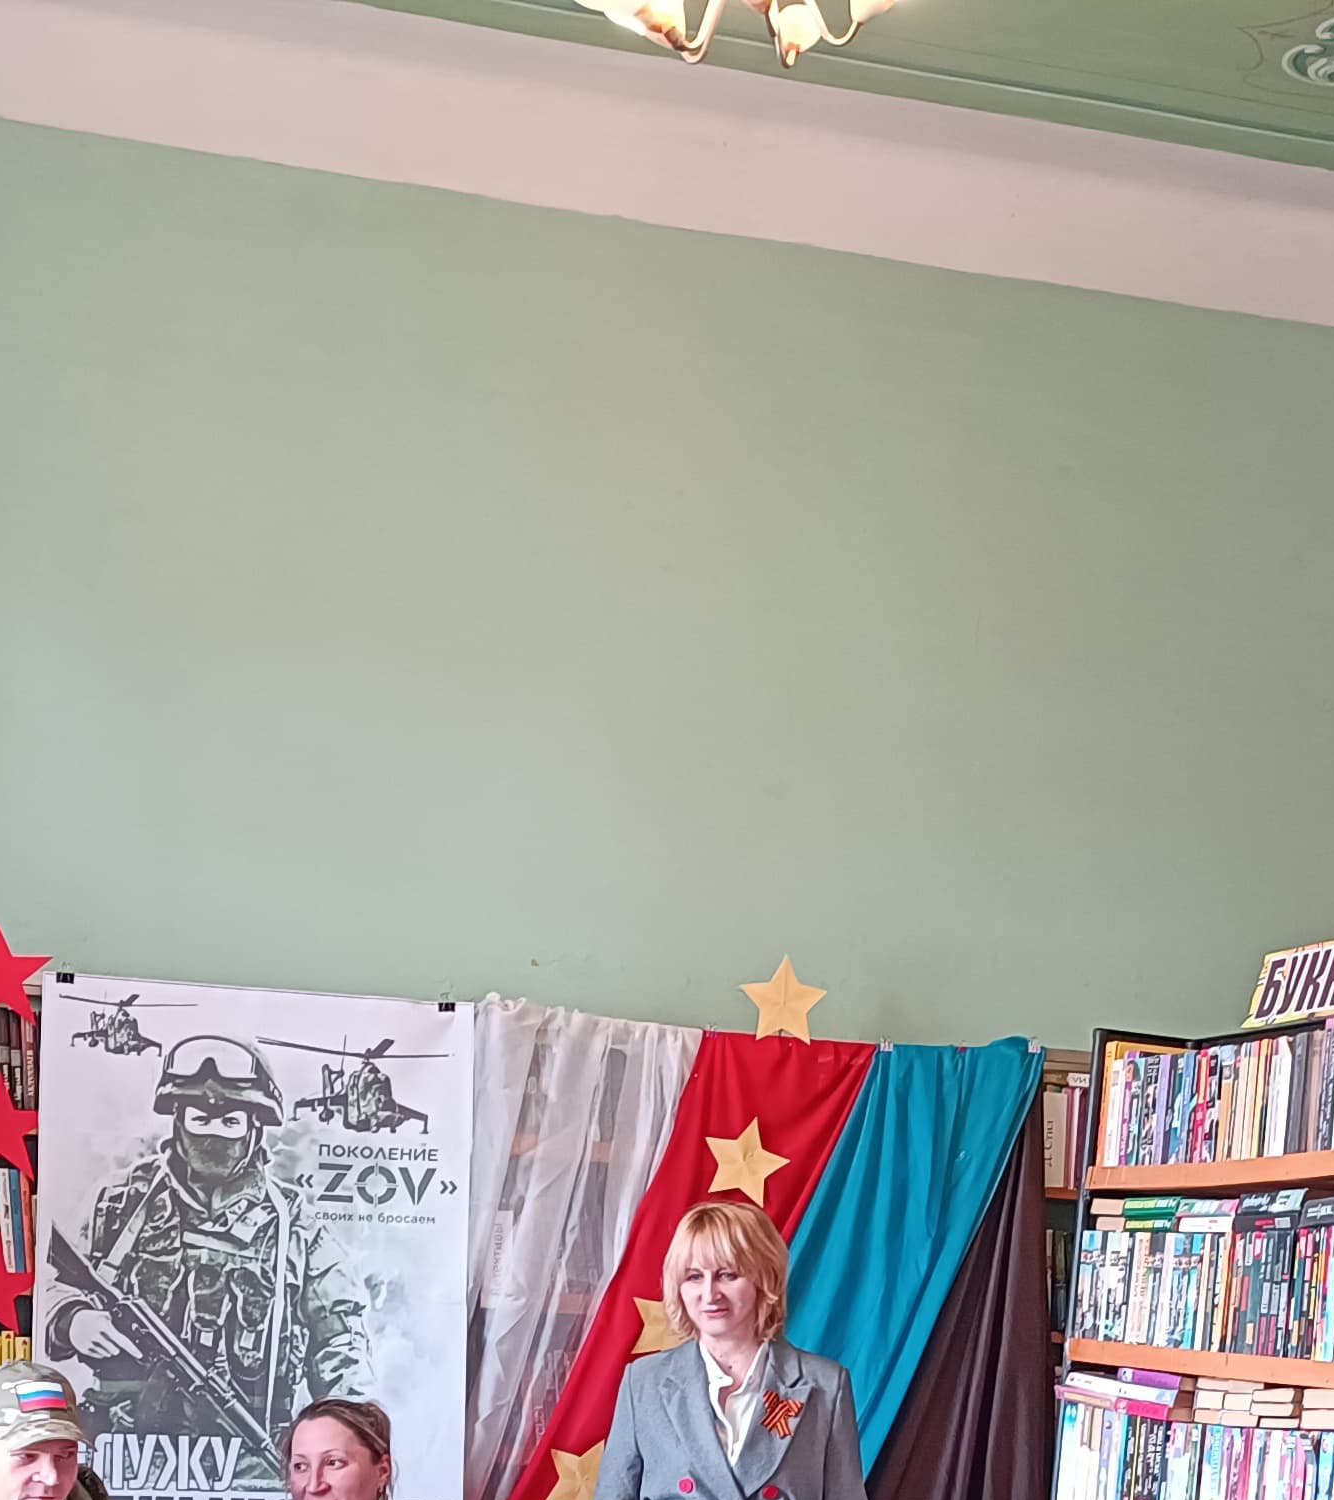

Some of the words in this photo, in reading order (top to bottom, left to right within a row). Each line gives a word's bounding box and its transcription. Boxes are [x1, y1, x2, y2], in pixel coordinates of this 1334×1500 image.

[317, 1143, 440, 1162] ПОКОЛЕНИЕ
[315, 1211, 354, 1223] своих
[358, 1213, 374, 1223] не
[377, 1211, 436, 1225] бросаем
[77, 1432, 244, 1492] ЛУЖУ
